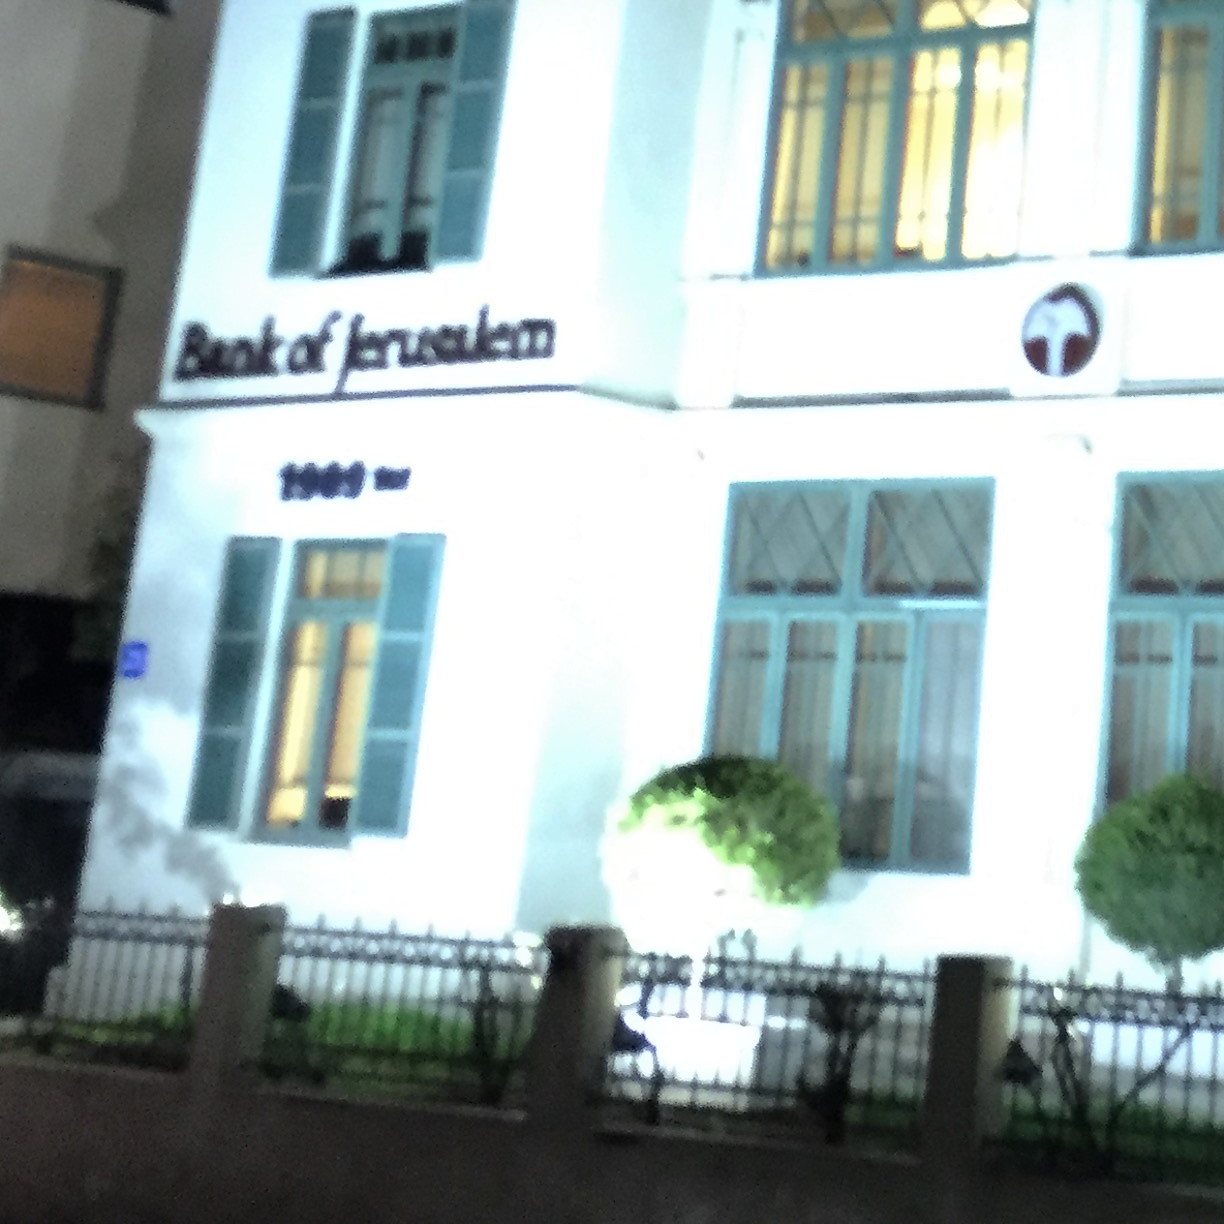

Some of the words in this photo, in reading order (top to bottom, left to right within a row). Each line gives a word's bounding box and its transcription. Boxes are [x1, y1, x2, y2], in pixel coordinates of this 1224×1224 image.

[174, 315, 285, 381] Bank
[288, 310, 342, 374] of
[336, 305, 557, 394] Jerusalem
